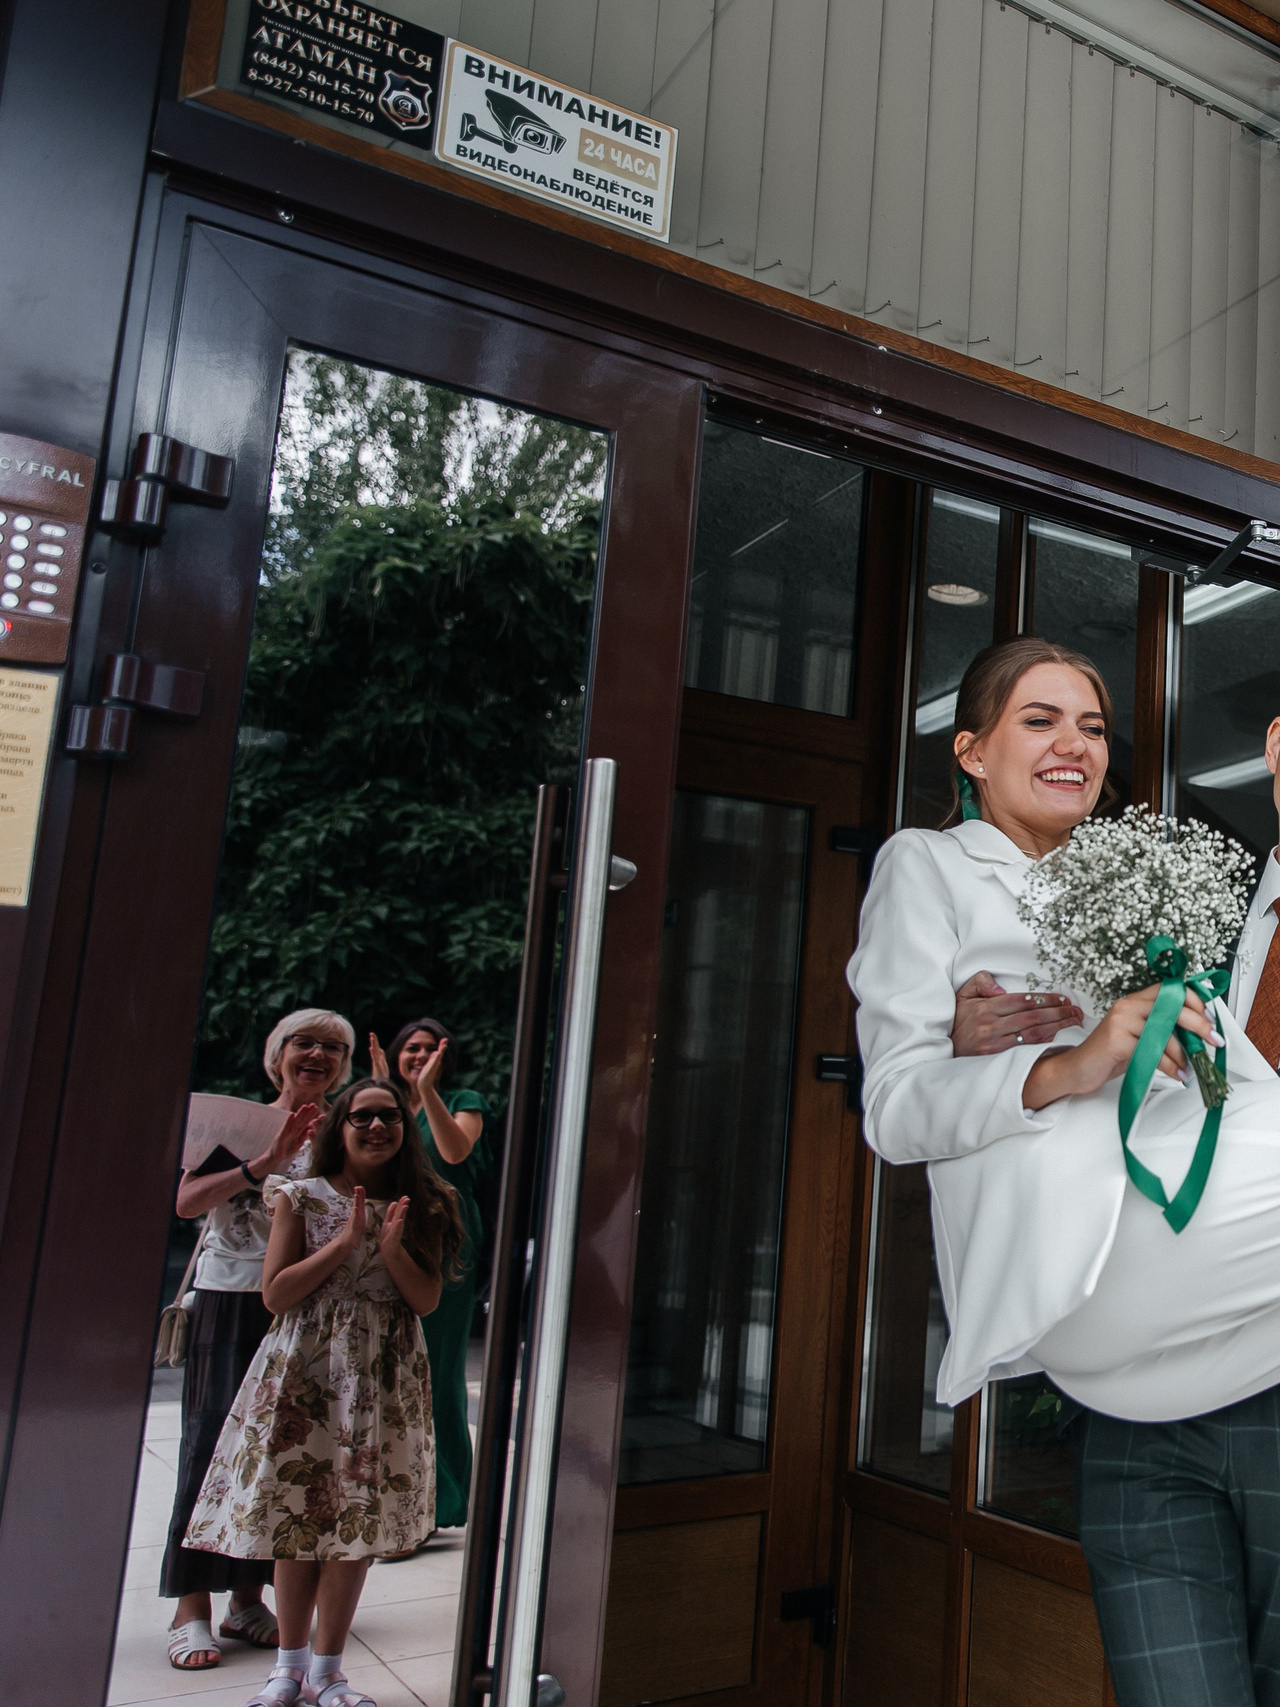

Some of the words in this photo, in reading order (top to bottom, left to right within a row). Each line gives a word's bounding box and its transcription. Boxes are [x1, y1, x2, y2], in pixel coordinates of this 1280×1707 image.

[252, 25, 377, 85] АТАМАН
[256, 0, 433, 73] ОХРАНЯЕТСЯ
[248, 67, 374, 123] 8-927-510-15-70
[253, 51, 303, 79] (8442)
[307, 70, 374, 104] 50-15-70
[463, 54, 662, 149] ВНИМАНИЕ!
[456, 143, 653, 226] ВИДЕОНАБЛЮДЕНИЕ
[573, 168, 654, 208] ВЕДЁТСЯ
[583, 138, 605, 161] 24
[610, 147, 659, 182] ЧАСА
[0, 456, 85, 488] CYFRAL
